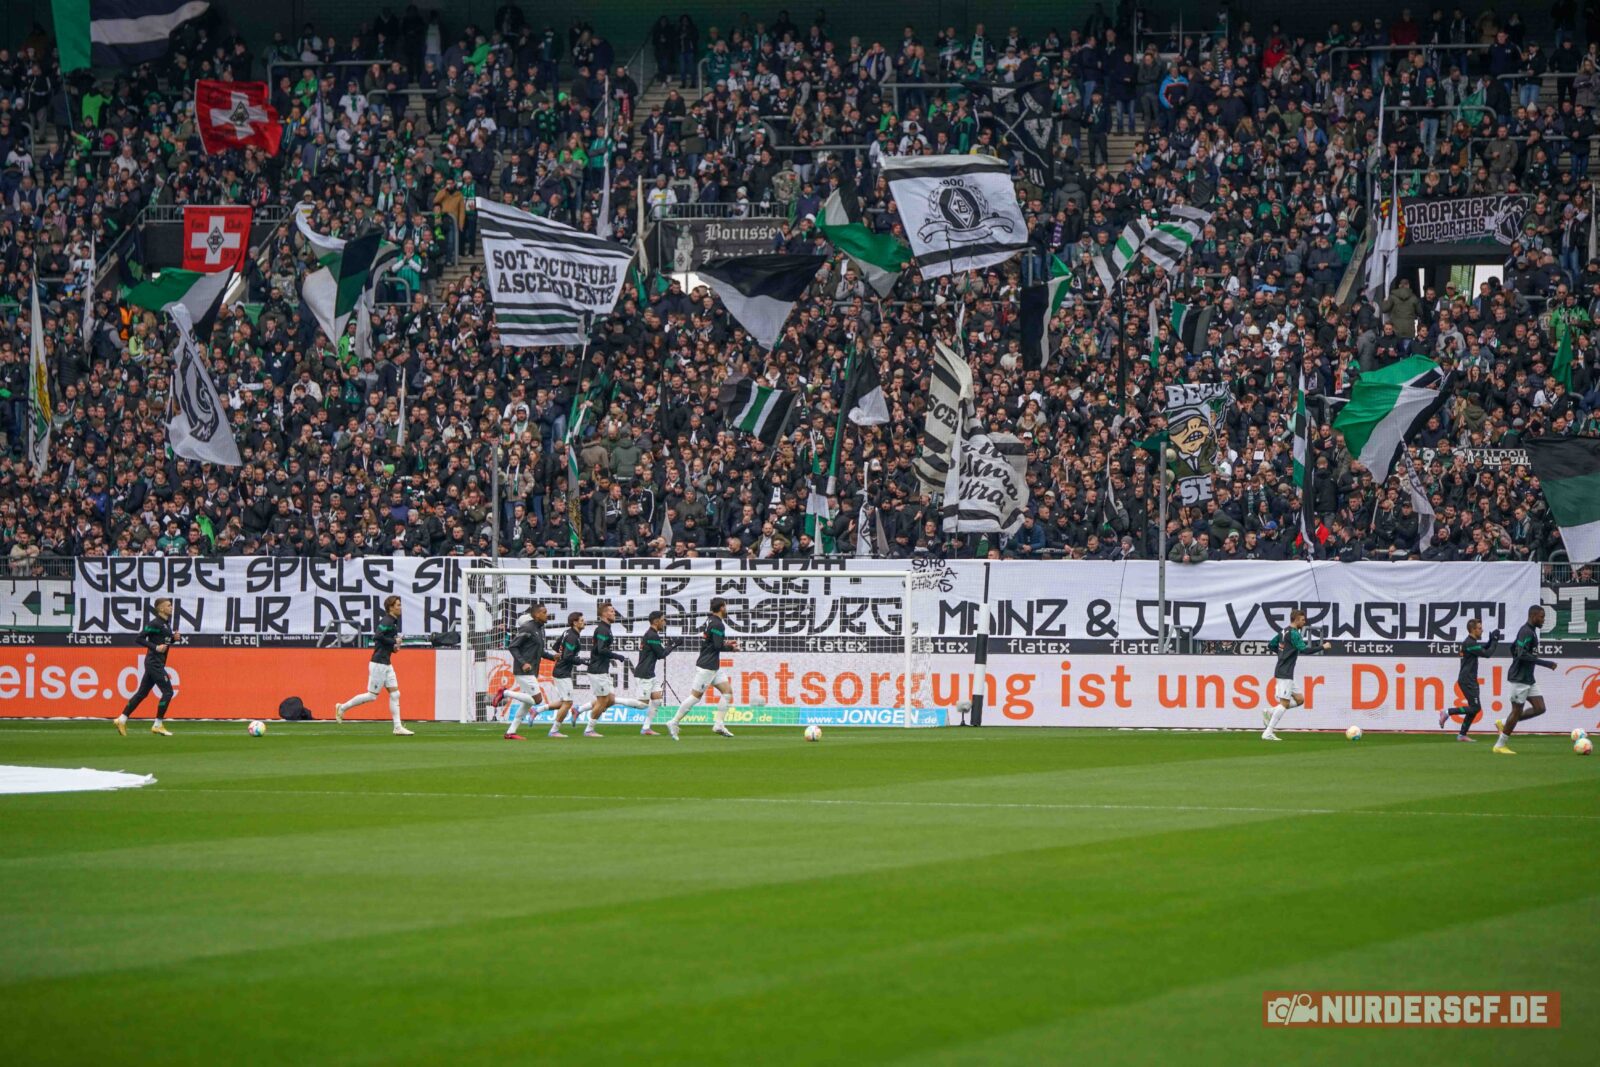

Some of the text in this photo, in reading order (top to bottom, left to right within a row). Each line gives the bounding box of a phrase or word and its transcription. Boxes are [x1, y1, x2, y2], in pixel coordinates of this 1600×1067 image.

[1405, 196, 1498, 227] DROPKICK
[704, 223, 782, 244] Borusse
[1412, 217, 1486, 242] SUPPORTERS
[246, 557, 394, 593] SPIELE
[412, 558, 507, 594] SIND
[530, 559, 692, 597] NICHTS
[715, 558, 847, 596] WERT
[225, 596, 291, 634] IHR
[937, 598, 1068, 637] MAINZ
[1085, 598, 1120, 639] &
[1225, 600, 1506, 641] VERWEHRT!
[0, 633, 35, 645] atex
[66, 632, 112, 645] flatex
[805, 637, 868, 652] flatex
[1007, 640, 1071, 654] flatex
[1344, 641, 1394, 654] flatex
[1060, 660, 1133, 708] ist
[836, 709, 920, 724] JONGEN
